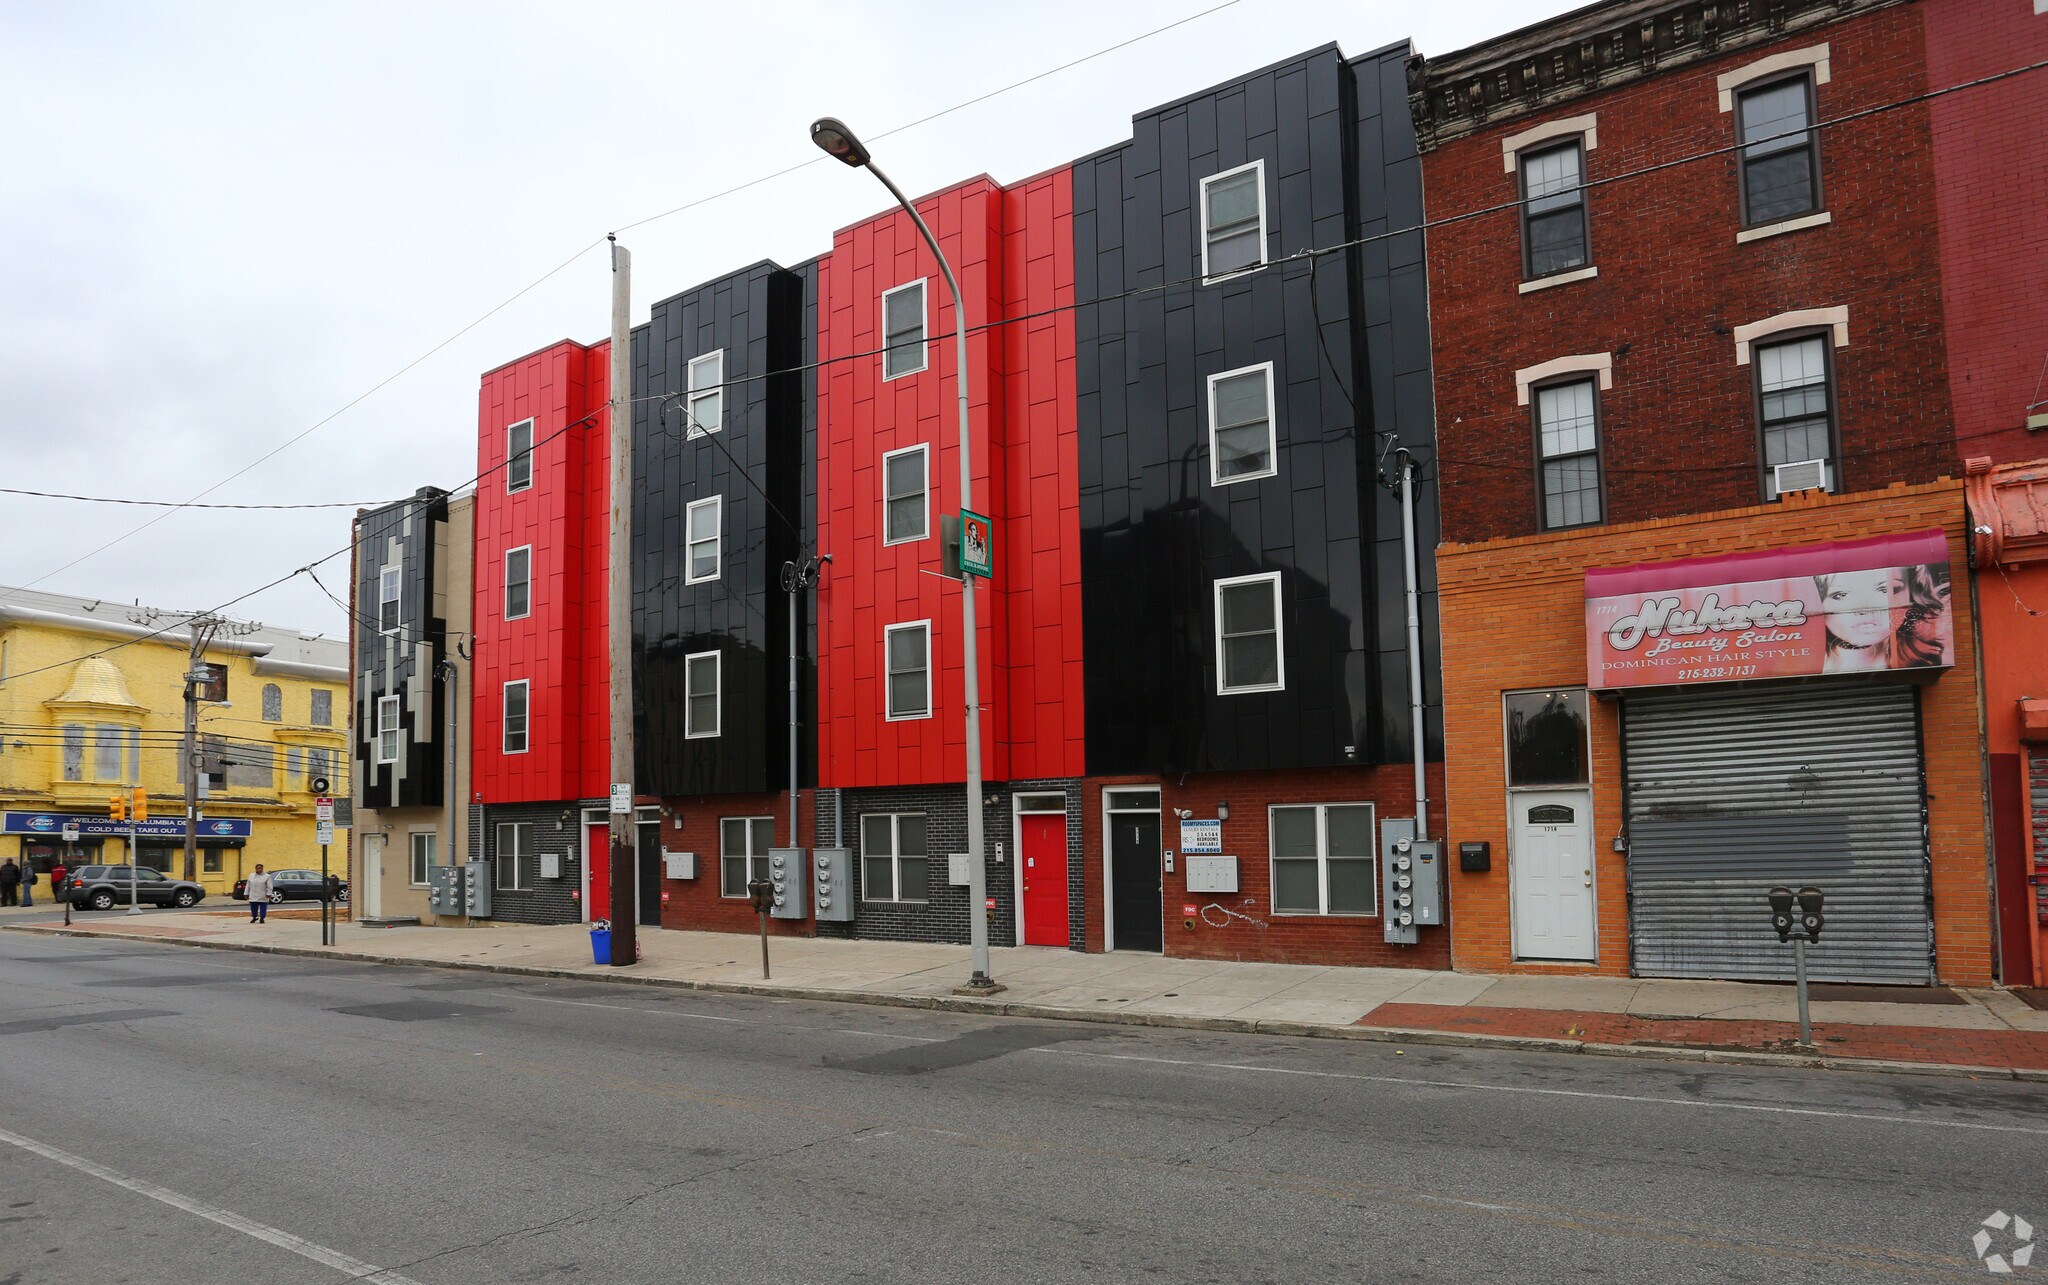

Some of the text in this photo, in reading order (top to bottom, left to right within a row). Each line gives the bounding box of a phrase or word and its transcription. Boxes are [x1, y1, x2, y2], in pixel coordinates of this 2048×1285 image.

[1596, 605, 1617, 615] 1714
[1608, 593, 1807, 651] Nukara
[1645, 629, 1803, 658] Beauty Salon
[1602, 647, 1811, 670] DOMINICAN HAIR STYLE
[1678, 665, 1757, 680] 215-232-1131
